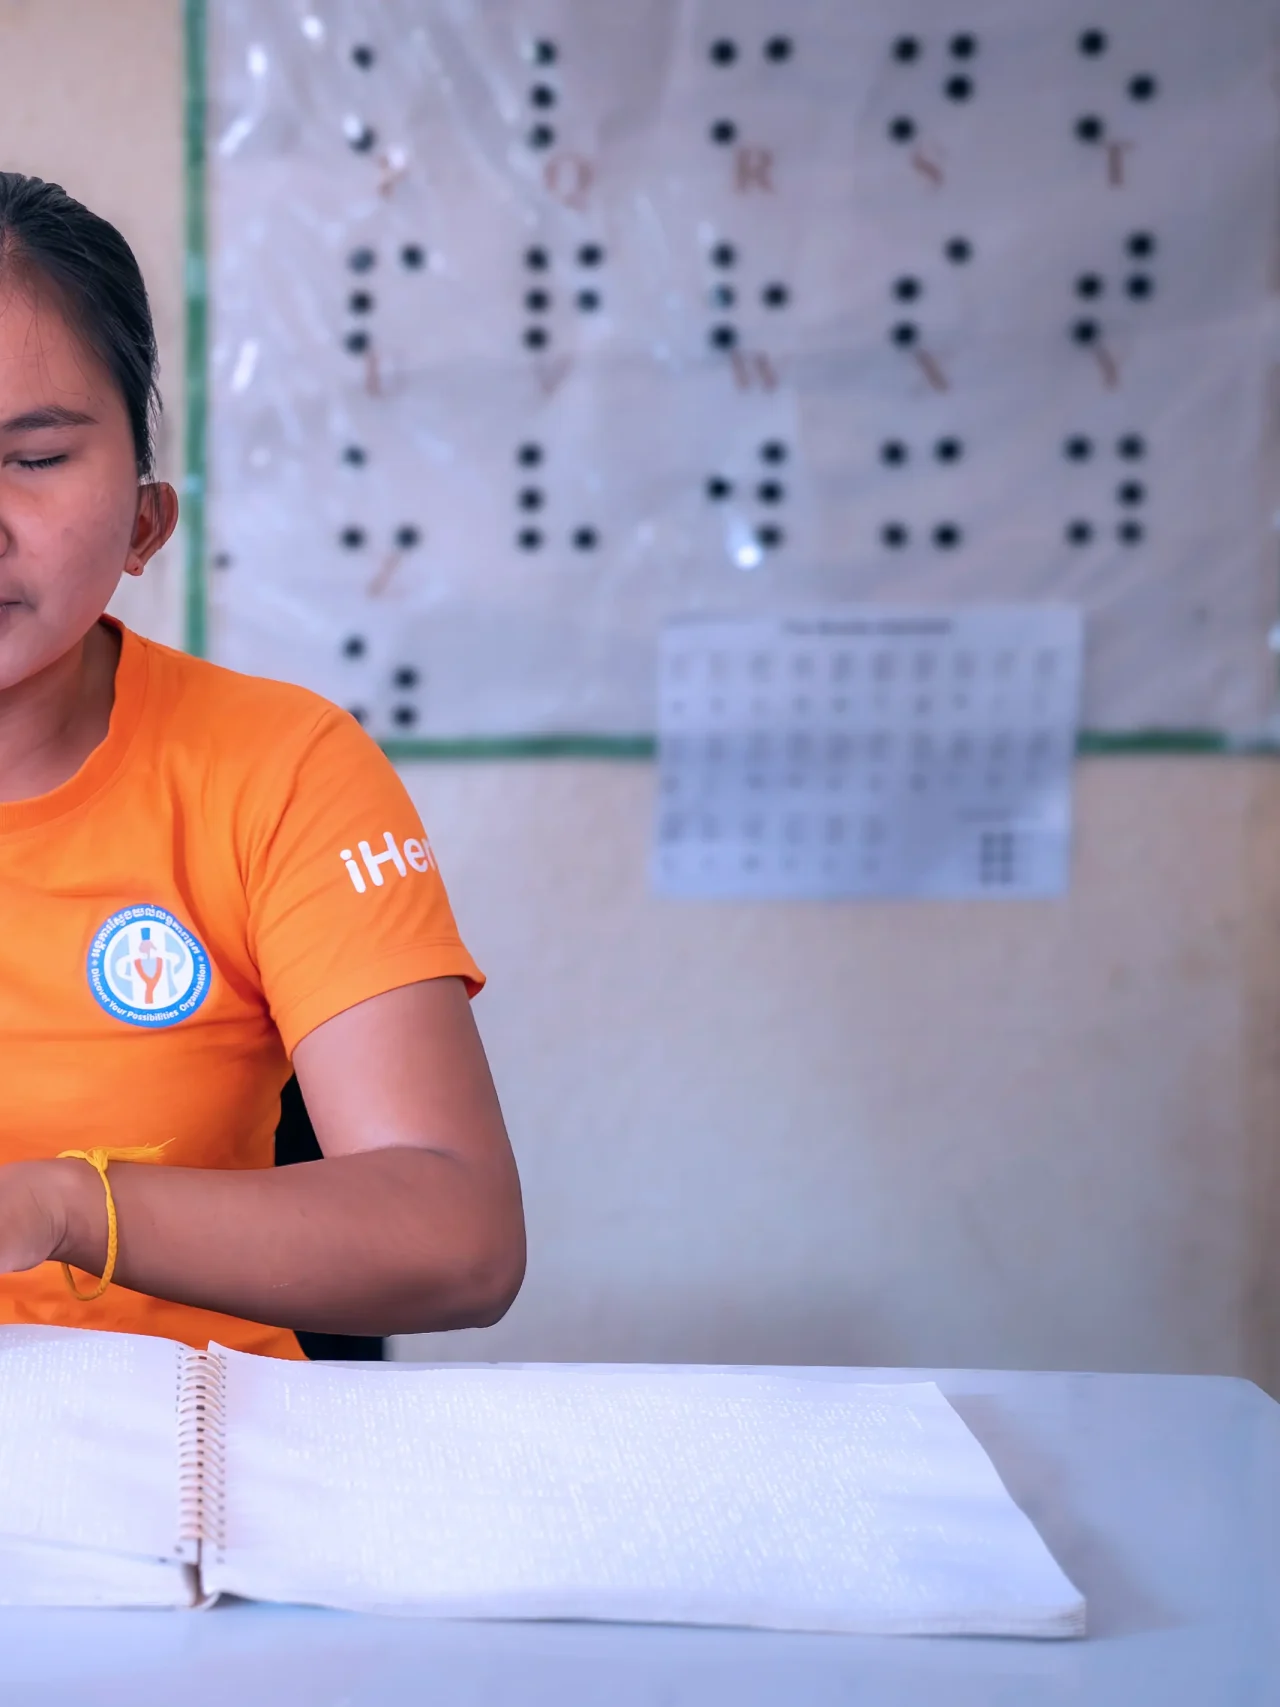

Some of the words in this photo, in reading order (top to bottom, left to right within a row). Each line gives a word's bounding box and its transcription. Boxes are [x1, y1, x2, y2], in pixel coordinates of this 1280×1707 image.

[734, 148, 776, 194] R
[91, 968, 110, 1003] Discover
[109, 1000, 127, 1015] Your
[127, 1009, 179, 1022] Possibilities
[179, 963, 207, 1011] Organization
